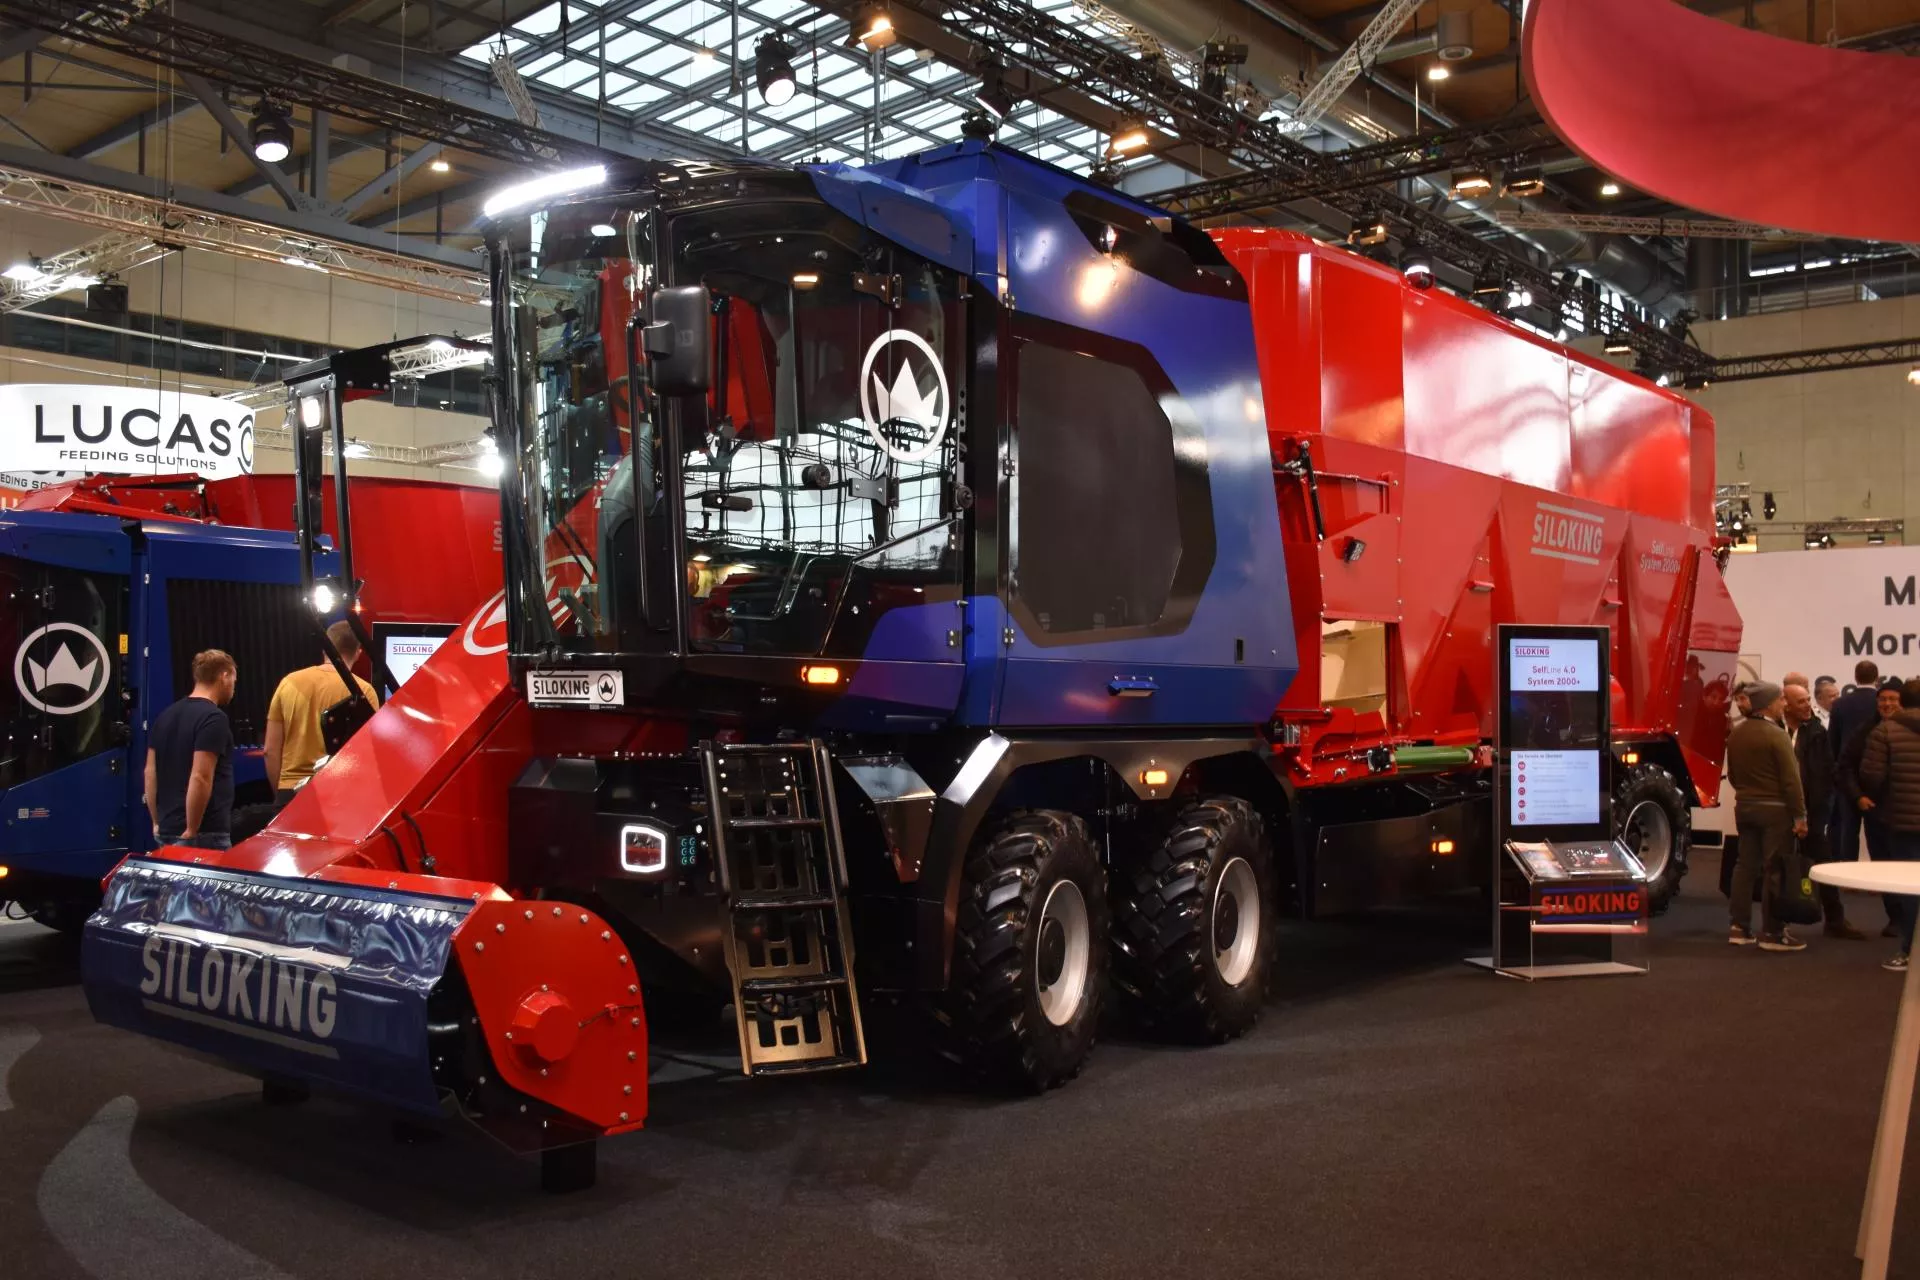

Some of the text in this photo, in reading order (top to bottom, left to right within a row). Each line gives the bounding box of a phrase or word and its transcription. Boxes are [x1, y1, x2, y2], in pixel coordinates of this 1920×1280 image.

[35, 404, 231, 457] LUCAS
[59, 450, 217, 471] FEEDING SOLUTIONS
[1532, 513, 1603, 555] SILOKING
[1883, 575, 1920, 606] M
[1842, 626, 1920, 656] Mor
[1528, 677, 1580, 687] System 2000+
[1532, 665, 1576, 674] SelfLine 4.0
[533, 680, 590, 696] SILOKING
[1541, 892, 1640, 915] SILOKING
[140, 935, 337, 1039] SILOKING
